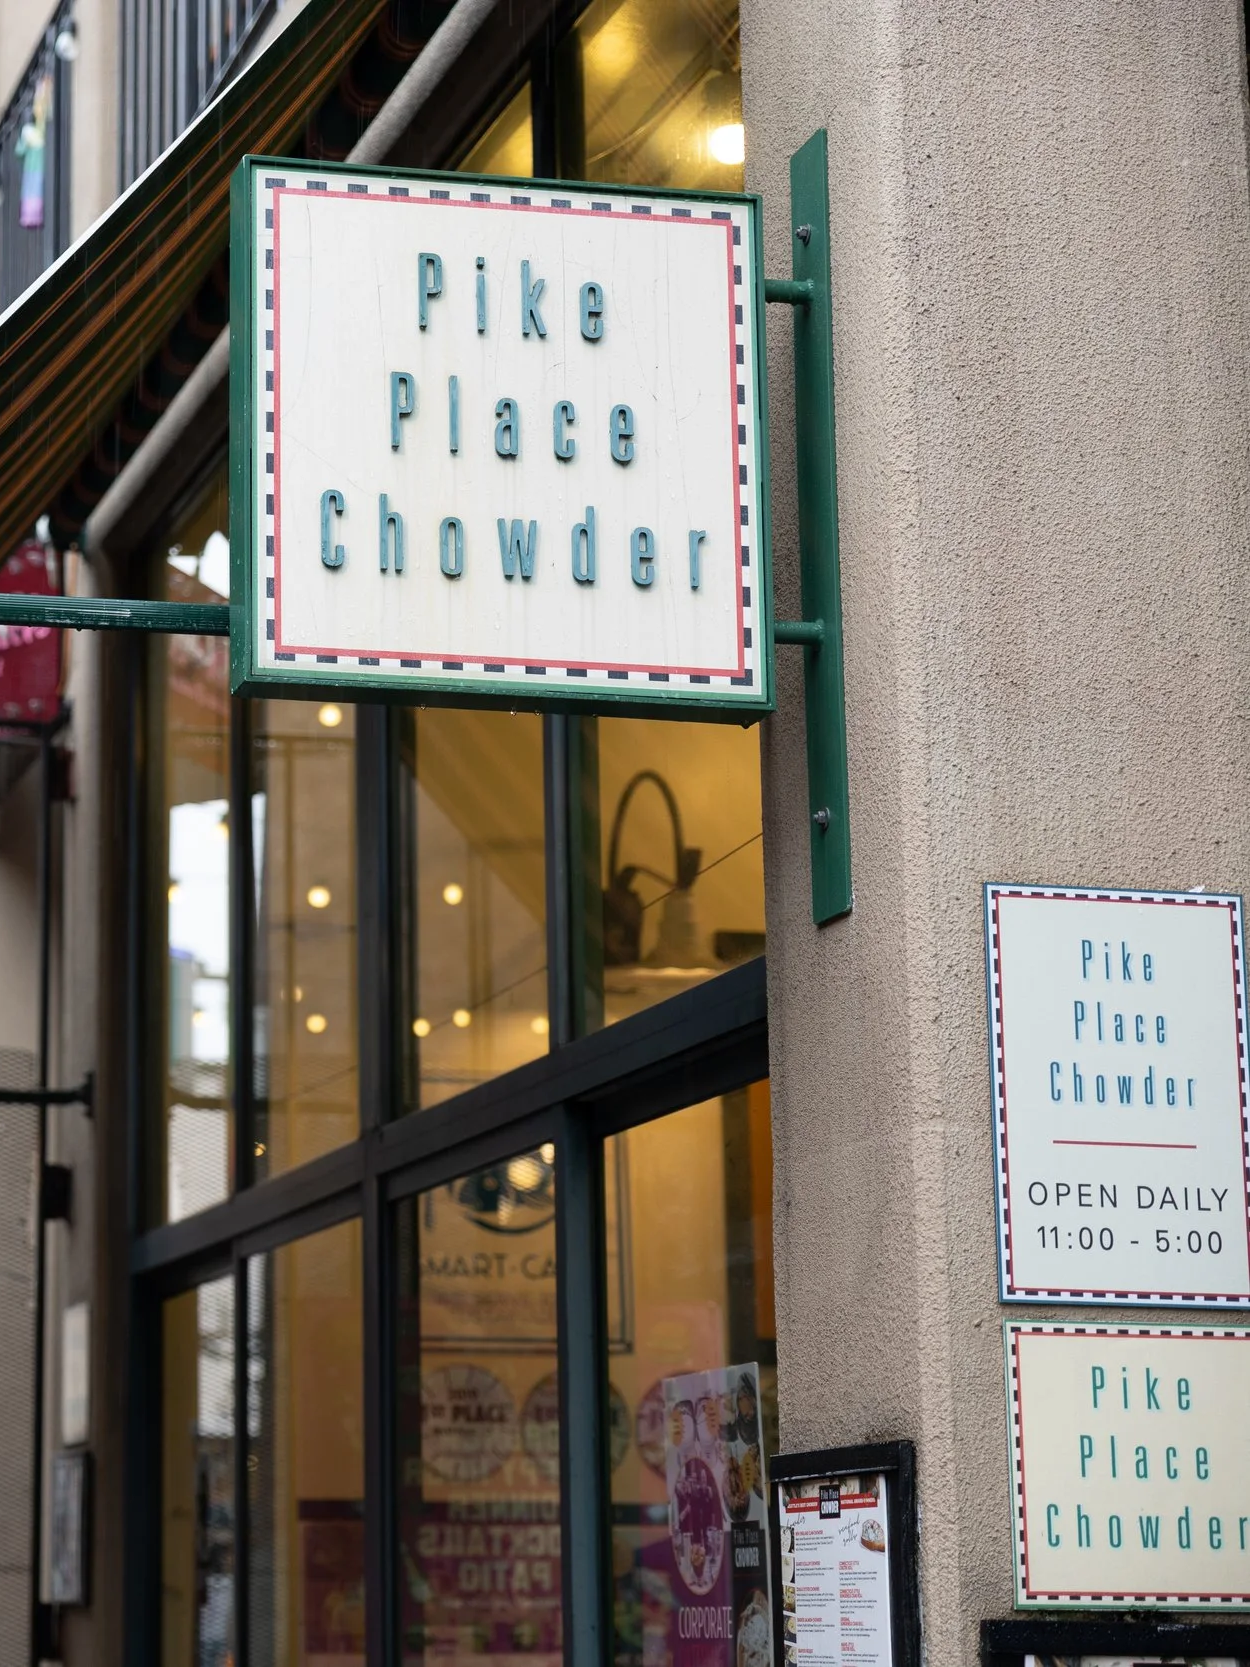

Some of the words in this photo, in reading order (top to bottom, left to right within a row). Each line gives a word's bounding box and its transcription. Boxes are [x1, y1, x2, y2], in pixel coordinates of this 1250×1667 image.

[418, 252, 604, 341] Pike
[390, 371, 636, 465] Place
[320, 489, 707, 590] Chowder
[1081, 939, 1153, 982] Pike
[1073, 1000, 1166, 1044] Place
[1050, 1061, 1195, 1107] Chowder
[1029, 1181, 1118, 1209] OPEN
[1137, 1186, 1228, 1212] DAILY
[1037, 1226, 1114, 1251] 11:00
[1156, 1229, 1223, 1254] 5:00
[421, 1253, 507, 1278] MART
[1091, 1366, 1190, 1411] Pike
[1080, 1434, 1209, 1481] Place
[1046, 1503, 1250, 1550] Chowder
[678, 1606, 733, 1639] CORPORATE
